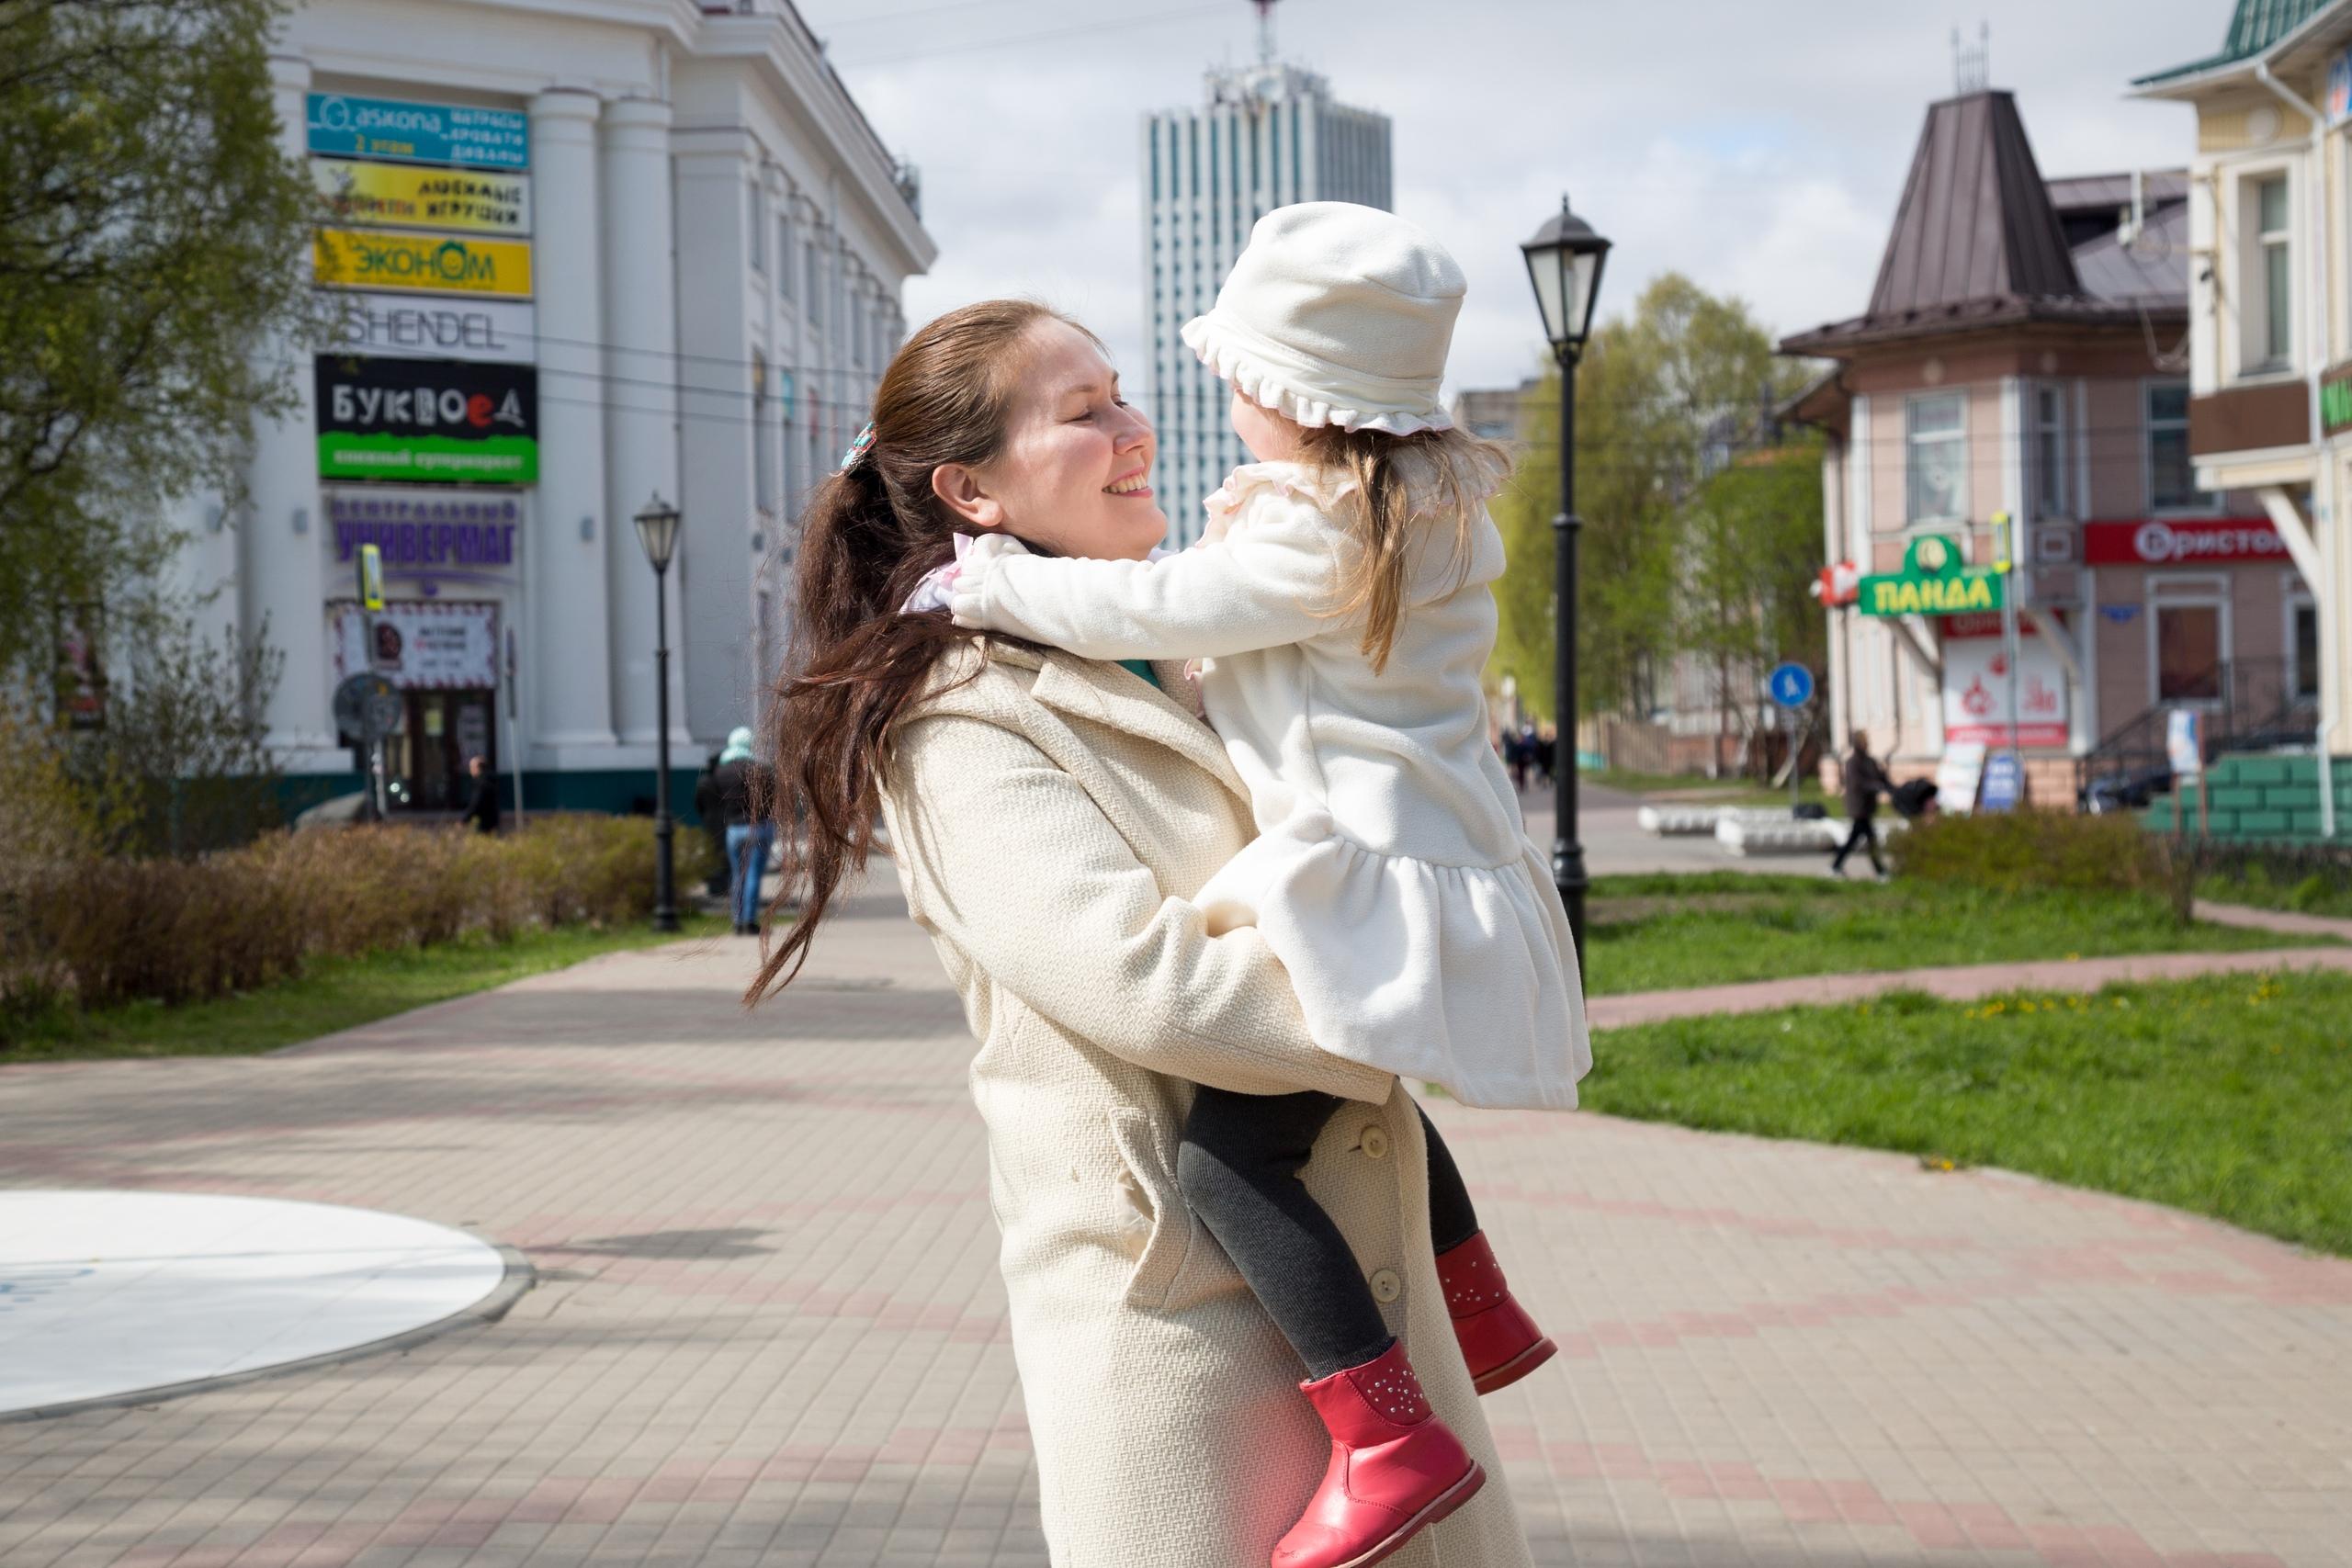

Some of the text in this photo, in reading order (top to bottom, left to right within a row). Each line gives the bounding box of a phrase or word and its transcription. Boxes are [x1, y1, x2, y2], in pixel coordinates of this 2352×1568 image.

[355, 132, 365, 152] 2
[354, 238, 497, 280] ЭКОНОМ
[344, 308, 507, 350] SHENDEL
[336, 520, 516, 565] УНИВЕРМАГ
[1872, 576, 1993, 614] ПАНДА
